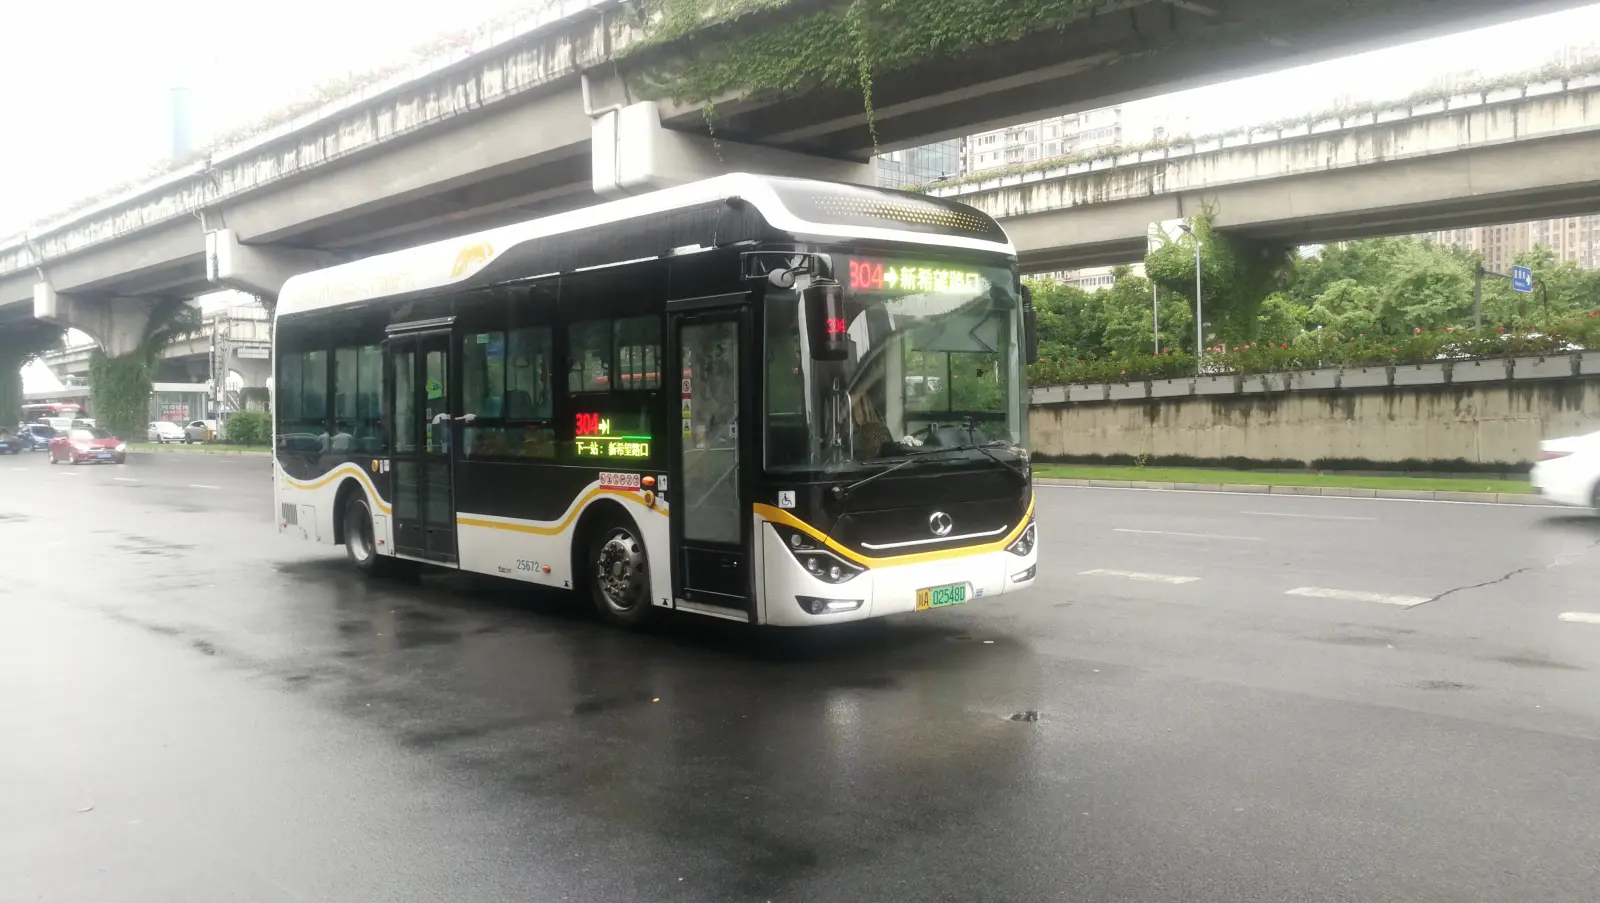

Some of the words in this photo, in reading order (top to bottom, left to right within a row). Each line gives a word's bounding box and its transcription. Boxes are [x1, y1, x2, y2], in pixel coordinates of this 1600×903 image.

[849, 259, 884, 289] 304
[826, 317, 847, 334] 304
[575, 413, 599, 435] 304
[516, 559, 540, 573] 25672
